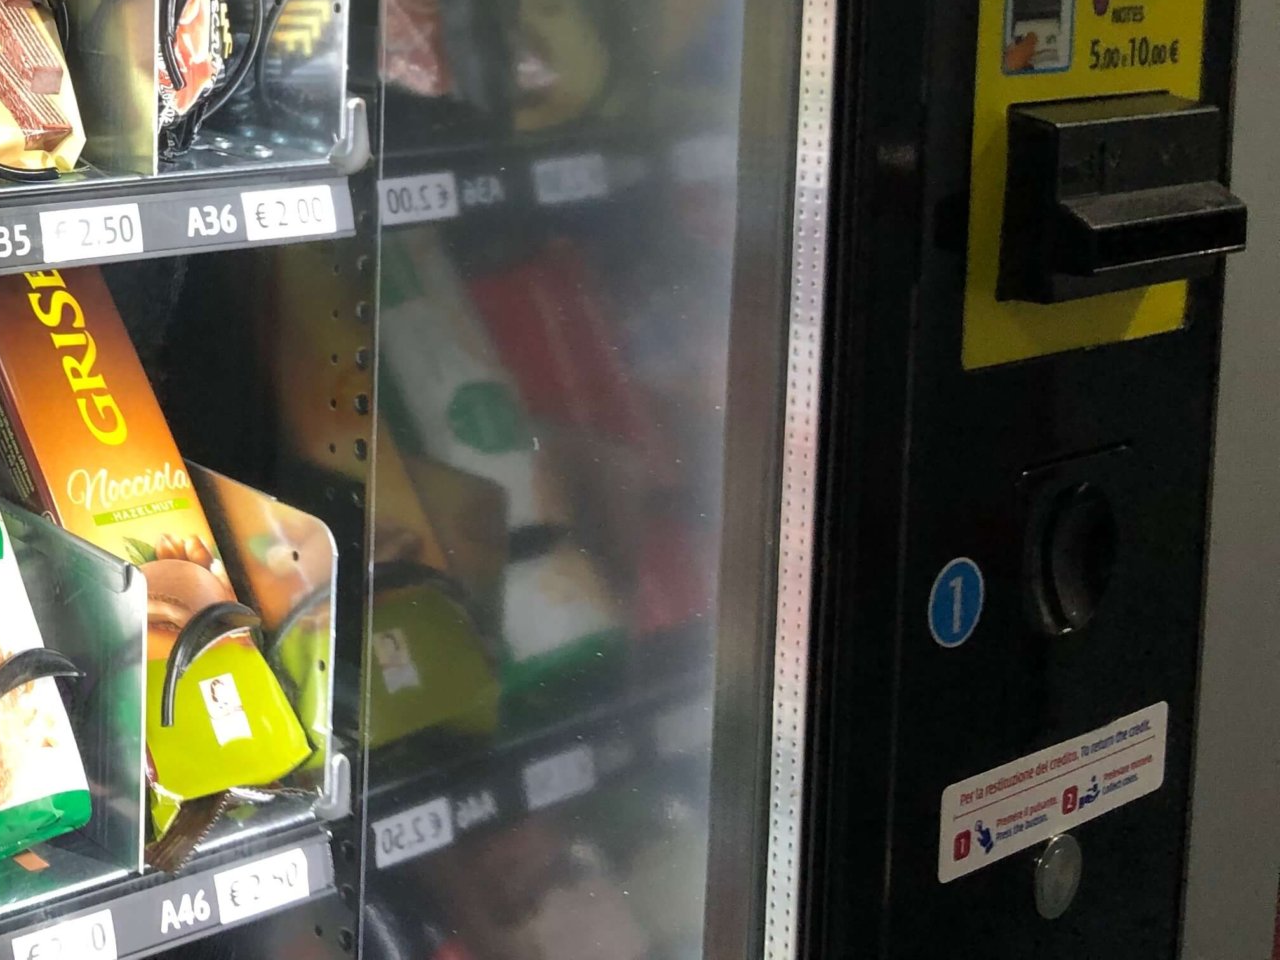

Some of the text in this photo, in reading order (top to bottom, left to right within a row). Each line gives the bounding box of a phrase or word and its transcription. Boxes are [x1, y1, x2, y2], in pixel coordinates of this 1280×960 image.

[187, 202, 270, 237] A36 €
[66, 461, 190, 512] Nocciola
[111, 499, 177, 522] HAZELNUT
[949, 575, 964, 634] 1
[959, 790, 973, 807] Per
[975, 786, 984, 800] la
[985, 768, 1035, 795] restituzione
[1036, 758, 1049, 777] del
[1080, 744, 1090, 758] To
[1090, 736, 1114, 755] return
[1116, 729, 1128, 745] the
[161, 892, 211, 934] A46
